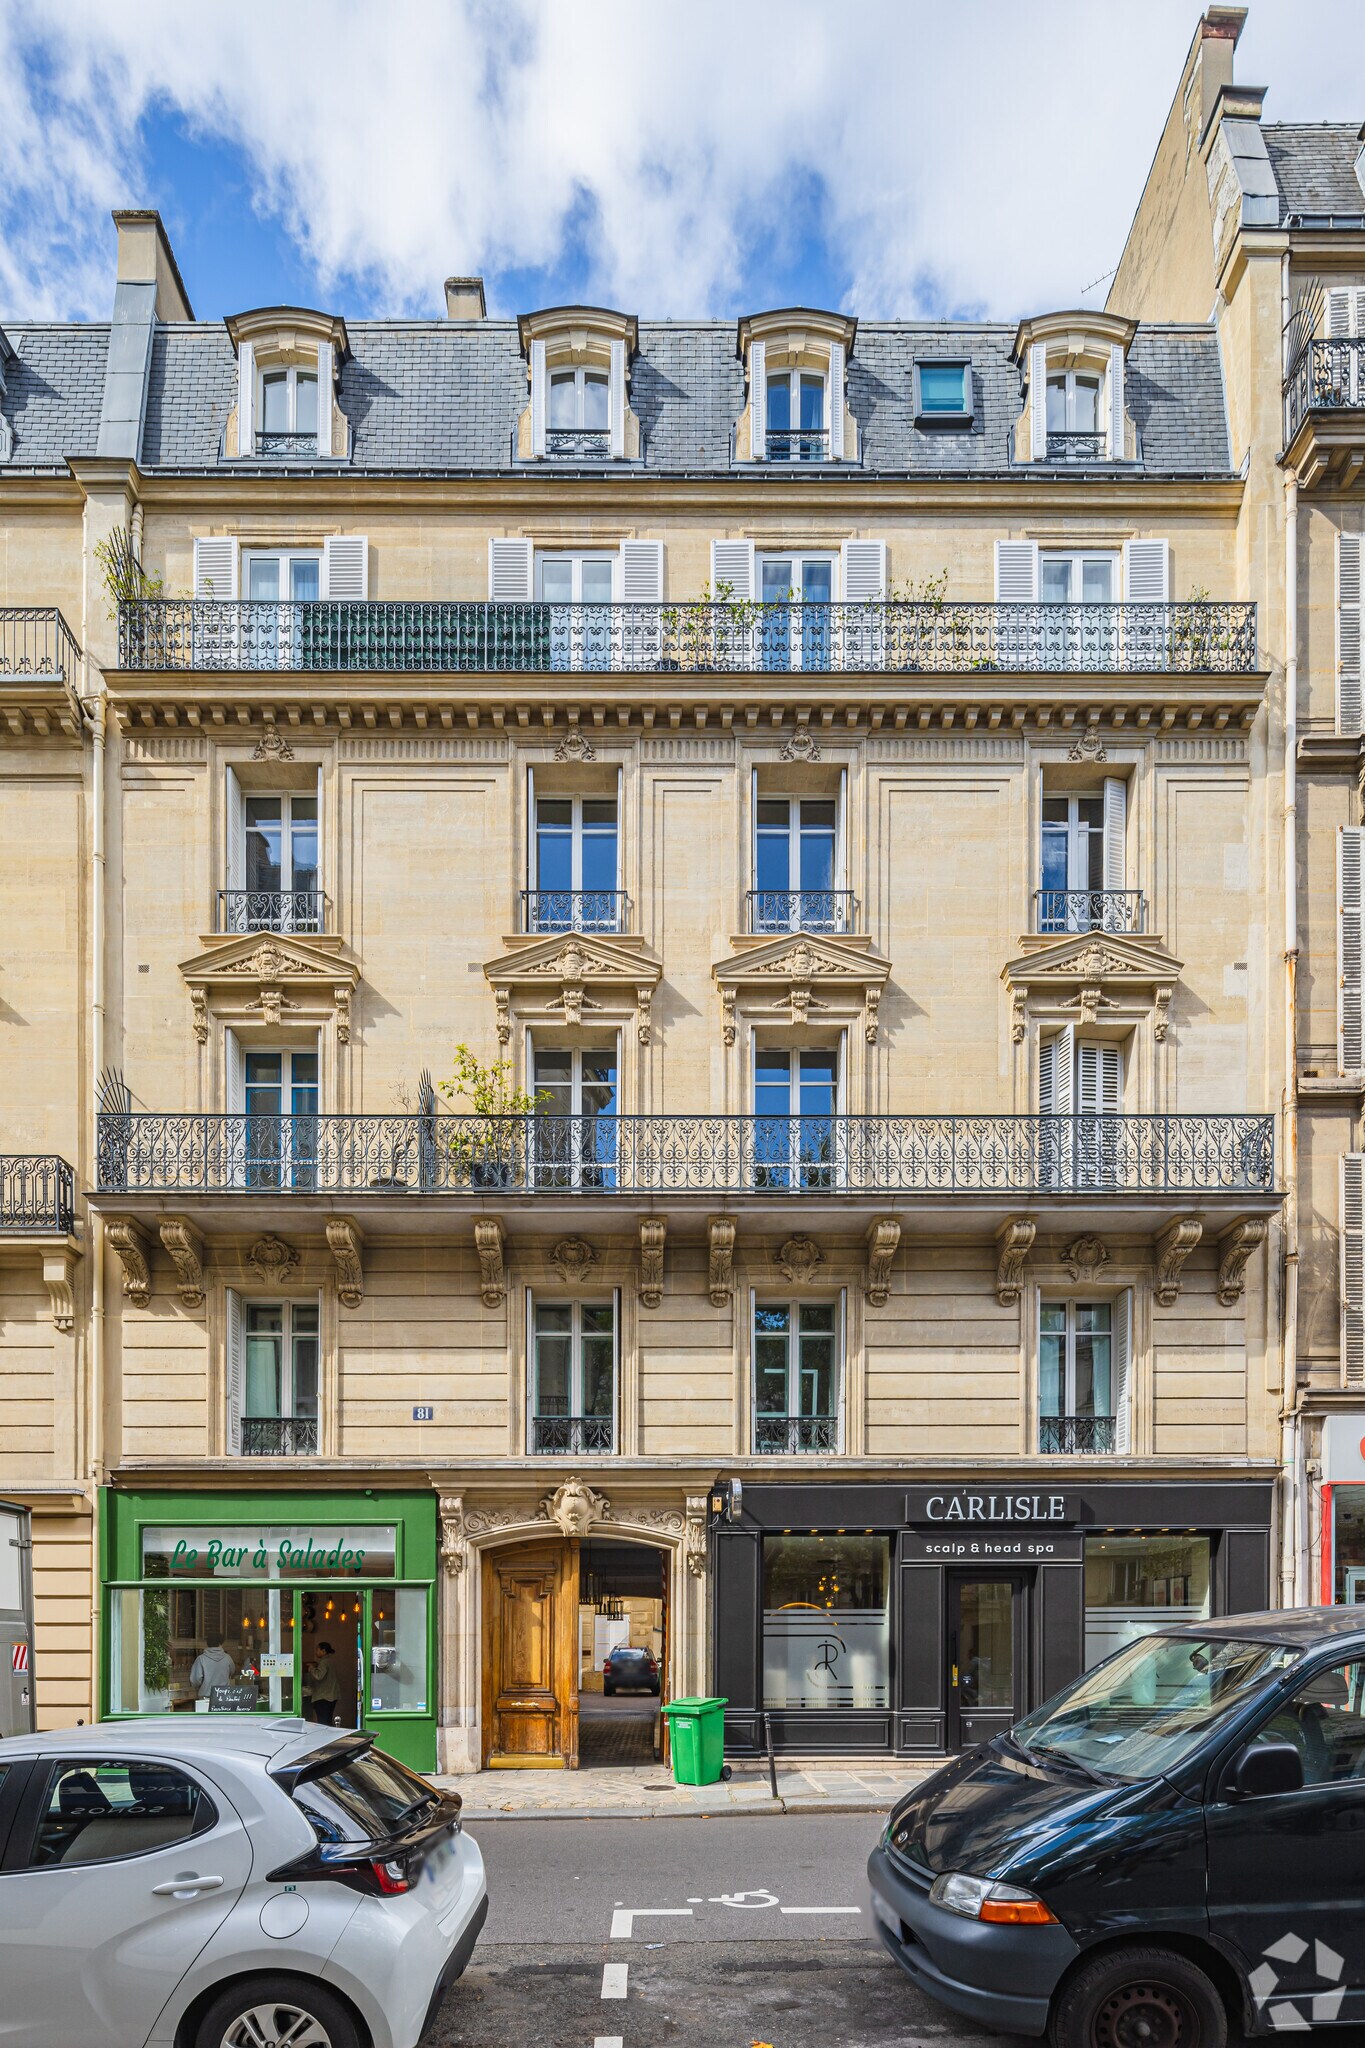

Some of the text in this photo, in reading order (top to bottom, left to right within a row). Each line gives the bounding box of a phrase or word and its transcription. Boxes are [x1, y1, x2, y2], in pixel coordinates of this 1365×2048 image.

[417, 1407, 430, 1420] 81
[926, 1496, 1065, 1520] CARLISLE
[169, 1537, 366, 1569] Le Bar à Salades
[925, 1542, 1054, 1556] scalp & head spa
